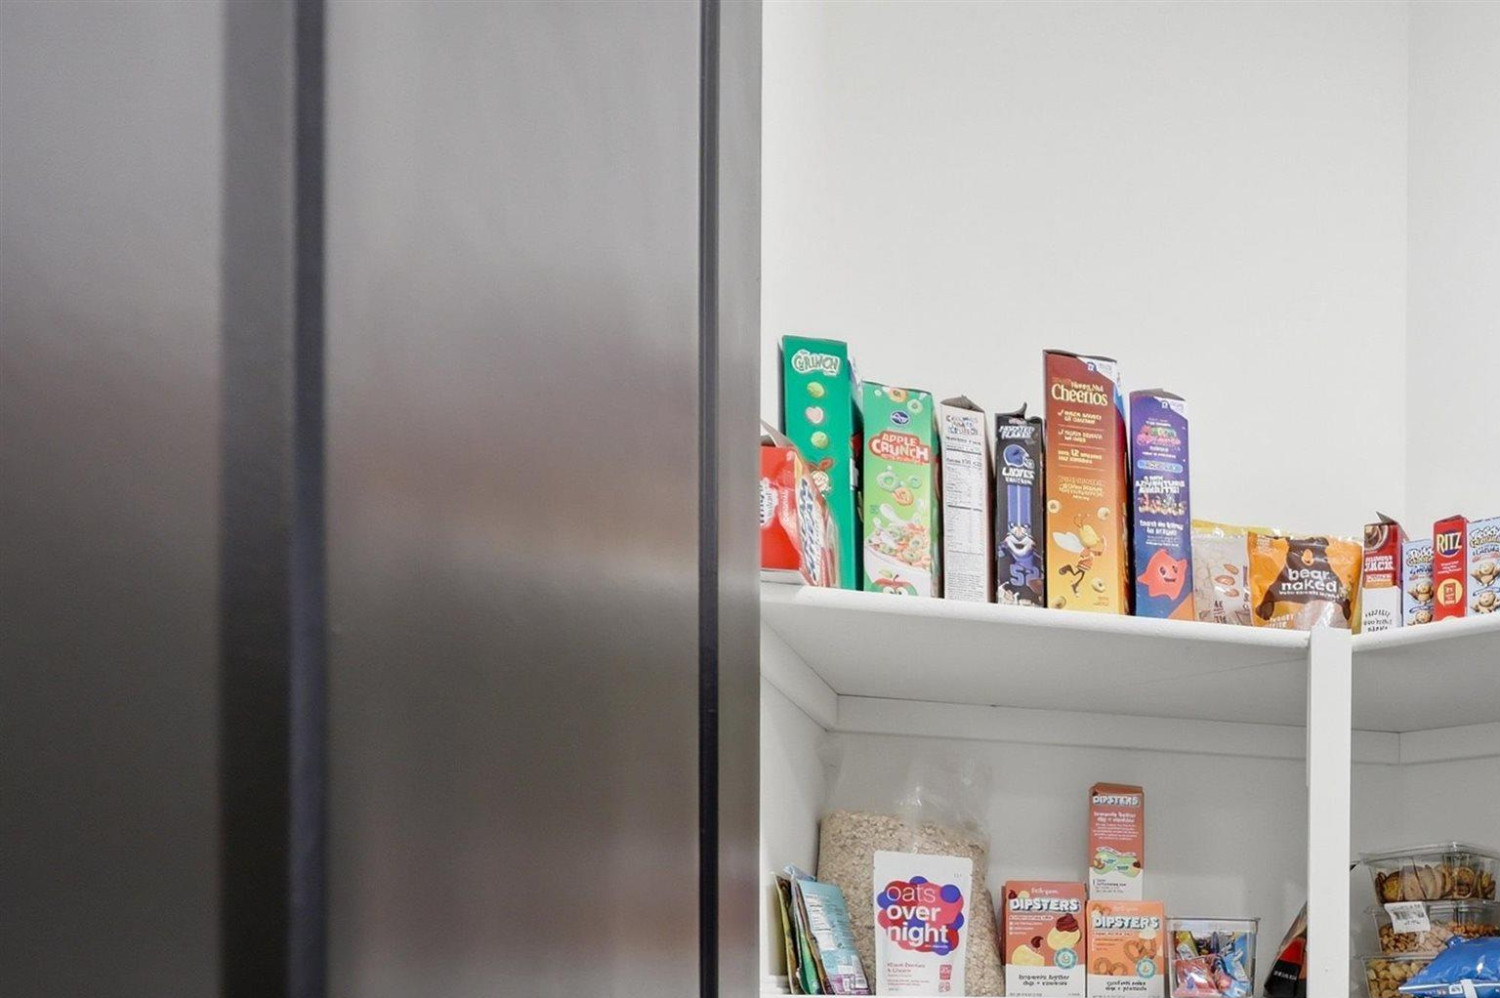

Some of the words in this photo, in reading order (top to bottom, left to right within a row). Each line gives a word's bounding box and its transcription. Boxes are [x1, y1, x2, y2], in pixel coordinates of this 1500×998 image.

[1051, 383, 1108, 407] Cheerios
[882, 433, 918, 446] APPLE
[871, 438, 929, 462] CRUNCH
[1436, 532, 1462, 553] RITZ
[1288, 568, 1329, 580] bear
[1281, 580, 1337, 592] naked
[886, 885, 936, 903] oats
[886, 904, 941, 920] over
[1010, 898, 1081, 912] DIPSTERS
[1092, 916, 1160, 930] DIPSTERS
[886, 923, 949, 947] night
